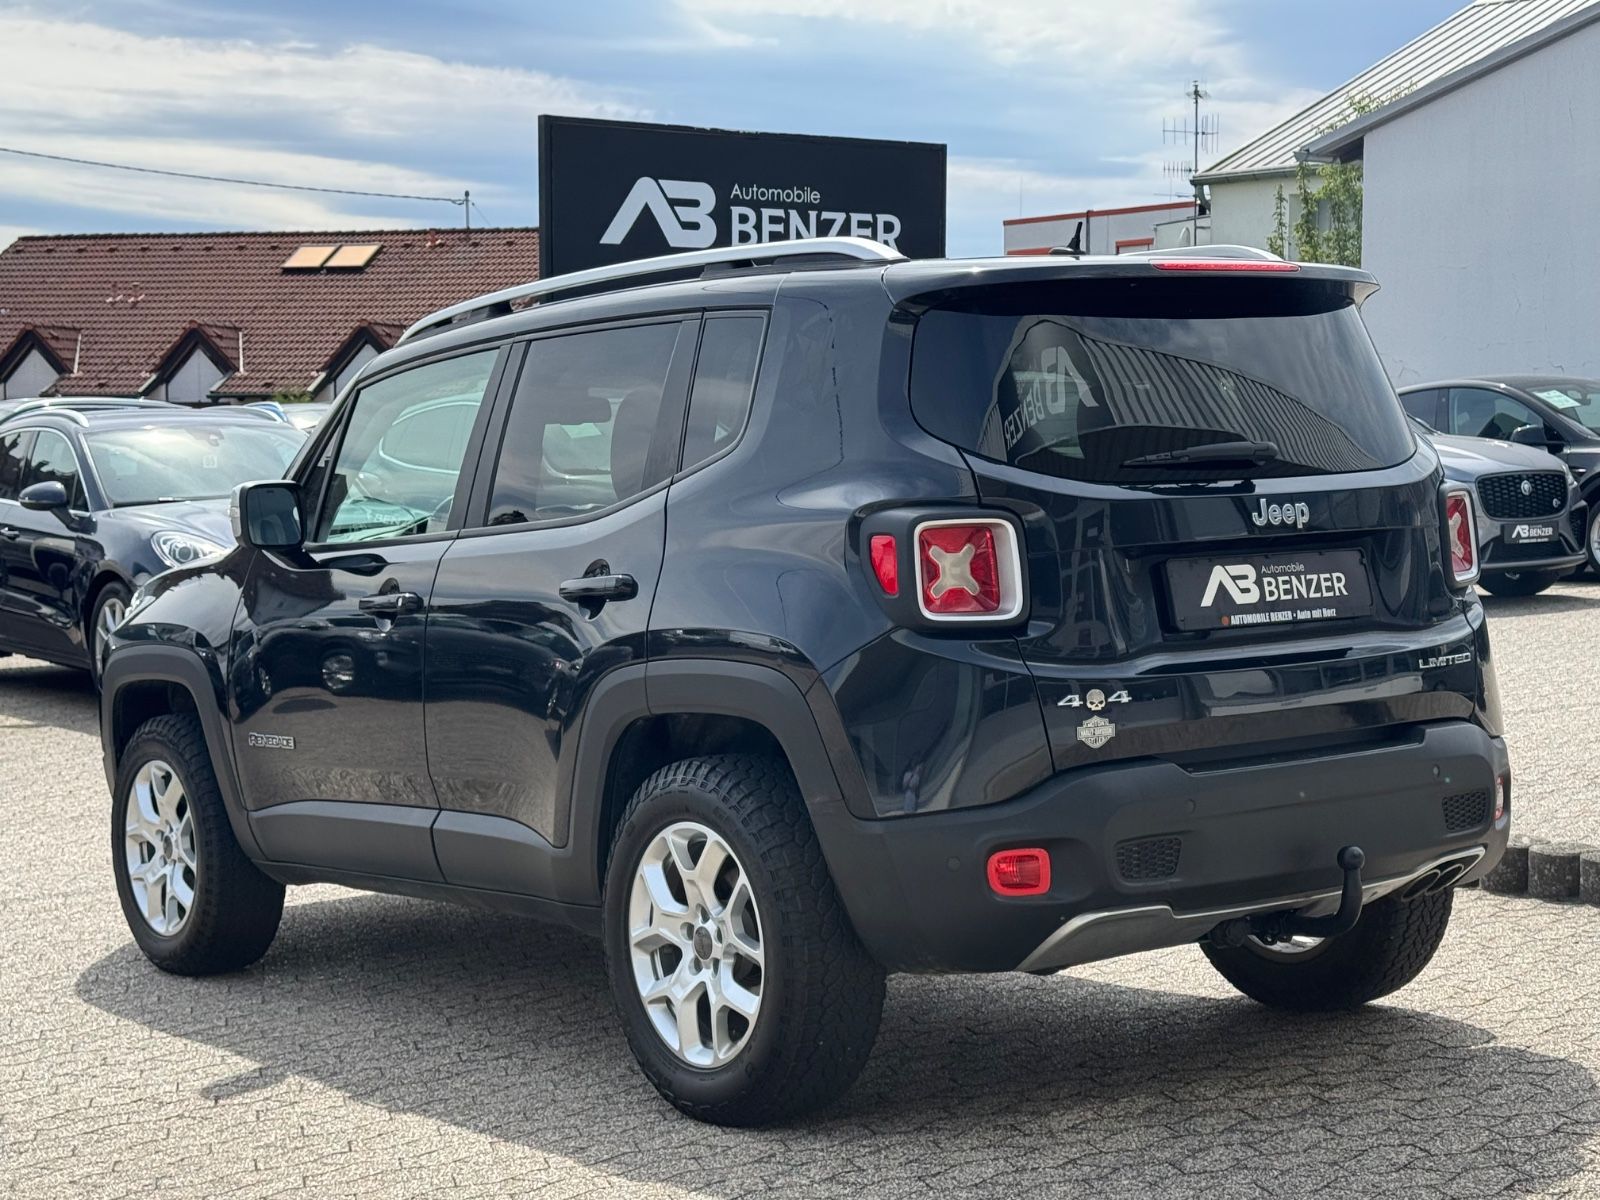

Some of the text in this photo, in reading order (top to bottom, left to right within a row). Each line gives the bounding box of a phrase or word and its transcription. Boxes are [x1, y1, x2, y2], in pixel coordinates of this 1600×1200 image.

[730, 183, 821, 204] Automobile
[1252, 498, 1310, 529] Jeep
[1260, 562, 1305, 574] Automobile
[1262, 572, 1349, 602] BENZER
[1230, 612, 1271, 626] AUTOMOBILE
[1270, 610, 1293, 622] BENZER
[1296, 609, 1312, 620] Auto
[1418, 652, 1472, 669] LIMITED
[1057, 691, 1132, 707] 4 4
[249, 732, 295, 749] RENEGADE
